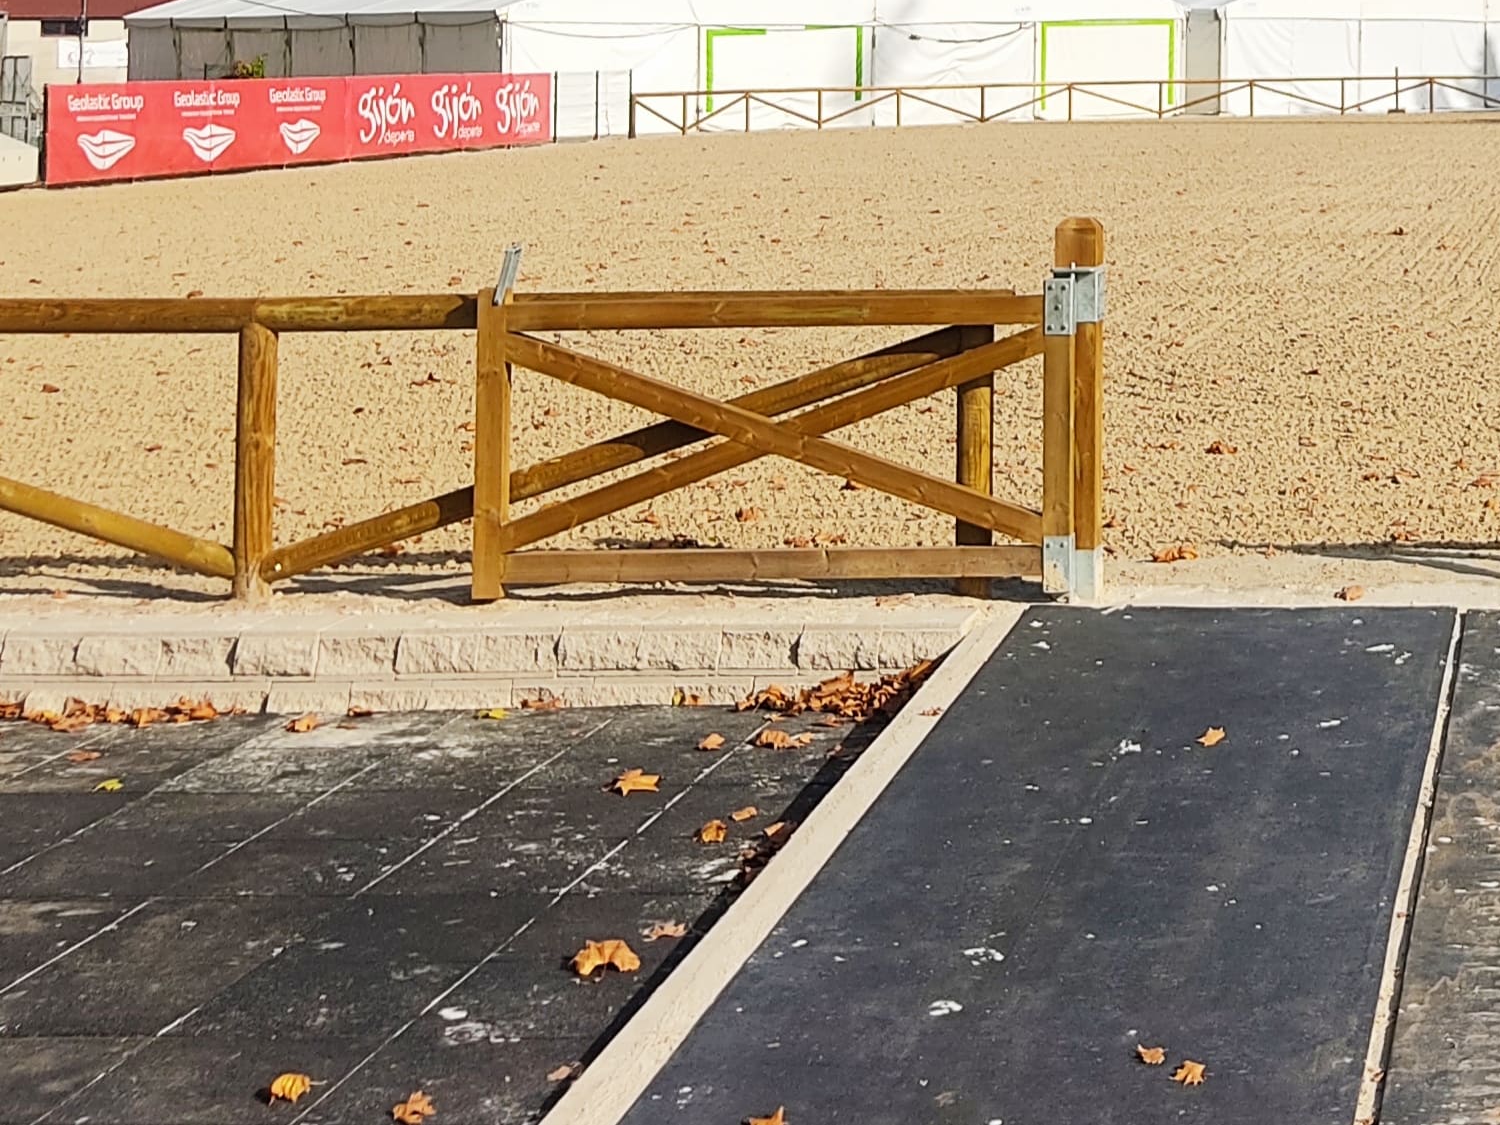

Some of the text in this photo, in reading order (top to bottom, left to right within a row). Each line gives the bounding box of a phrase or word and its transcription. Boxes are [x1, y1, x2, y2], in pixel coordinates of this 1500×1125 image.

[67, 93, 144, 113] Geolastic Group
[173, 89, 240, 109] Geolastic Group
[305, 87, 326, 105] Group
[358, 82, 416, 145] gijón
[431, 81, 482, 140] gijón
[495, 80, 540, 134] gijón
